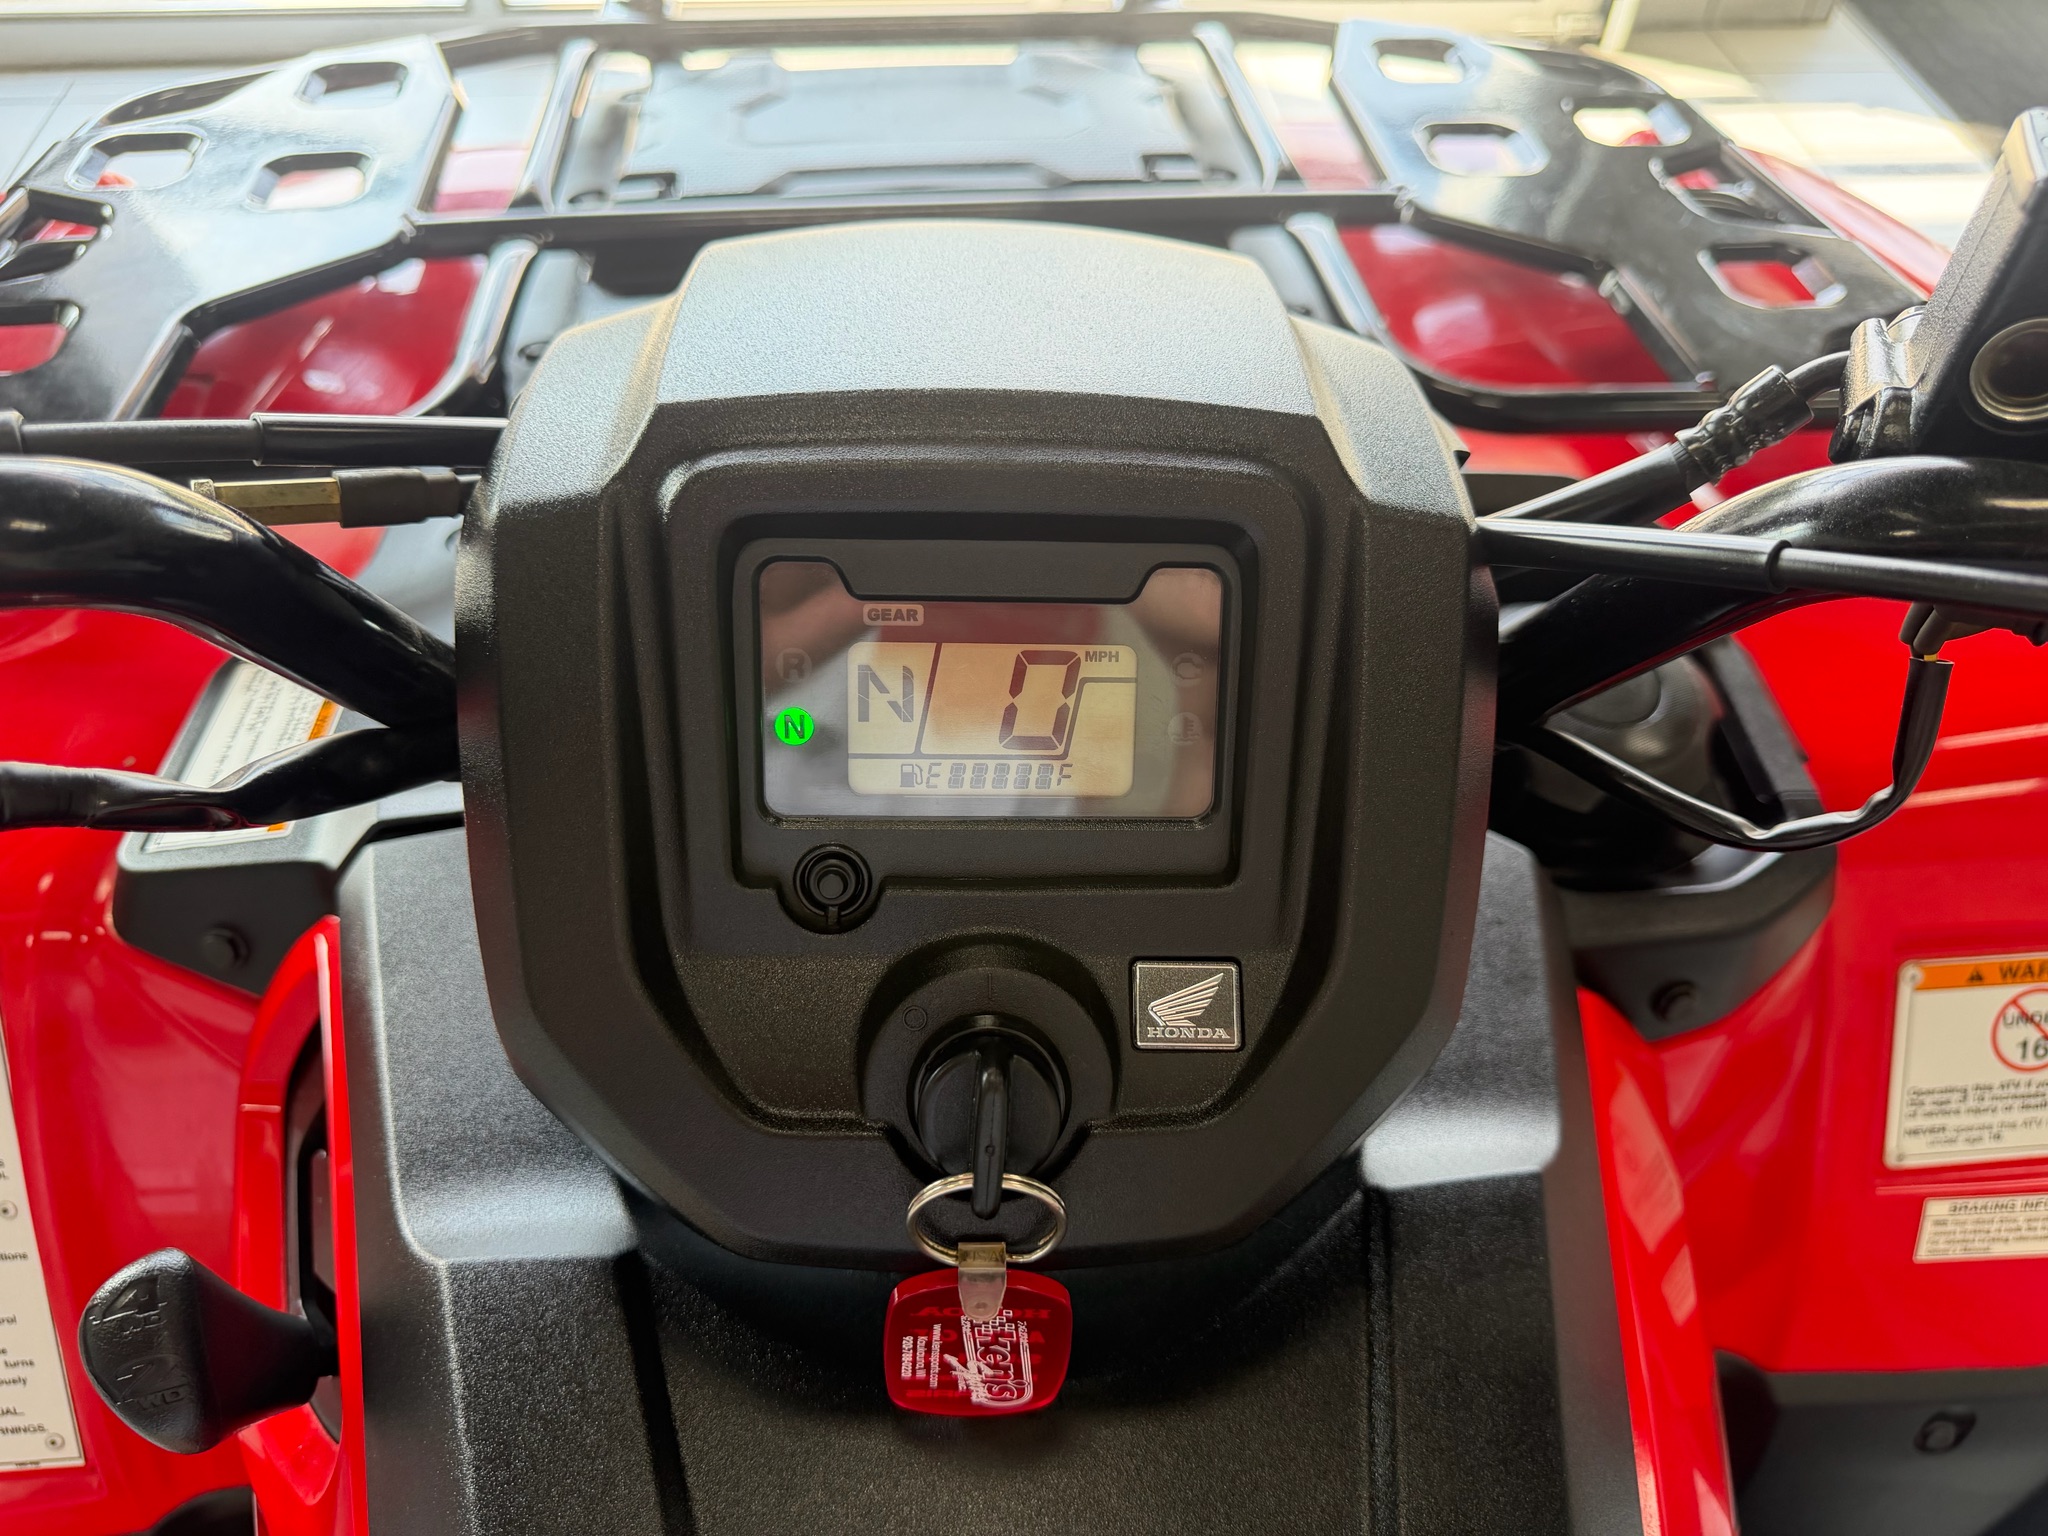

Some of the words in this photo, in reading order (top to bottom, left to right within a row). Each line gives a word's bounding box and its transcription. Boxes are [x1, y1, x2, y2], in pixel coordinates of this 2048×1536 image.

[867, 608, 919, 622] GEAR
[1084, 650, 1120, 663] MPH
[858, 664, 915, 722] N
[1000, 650, 1081, 750] 0
[783, 714, 805, 739] N
[925, 762, 942, 789] E
[1056, 763, 1073, 787] F
[1146, 1026, 1231, 1039] HONDA
